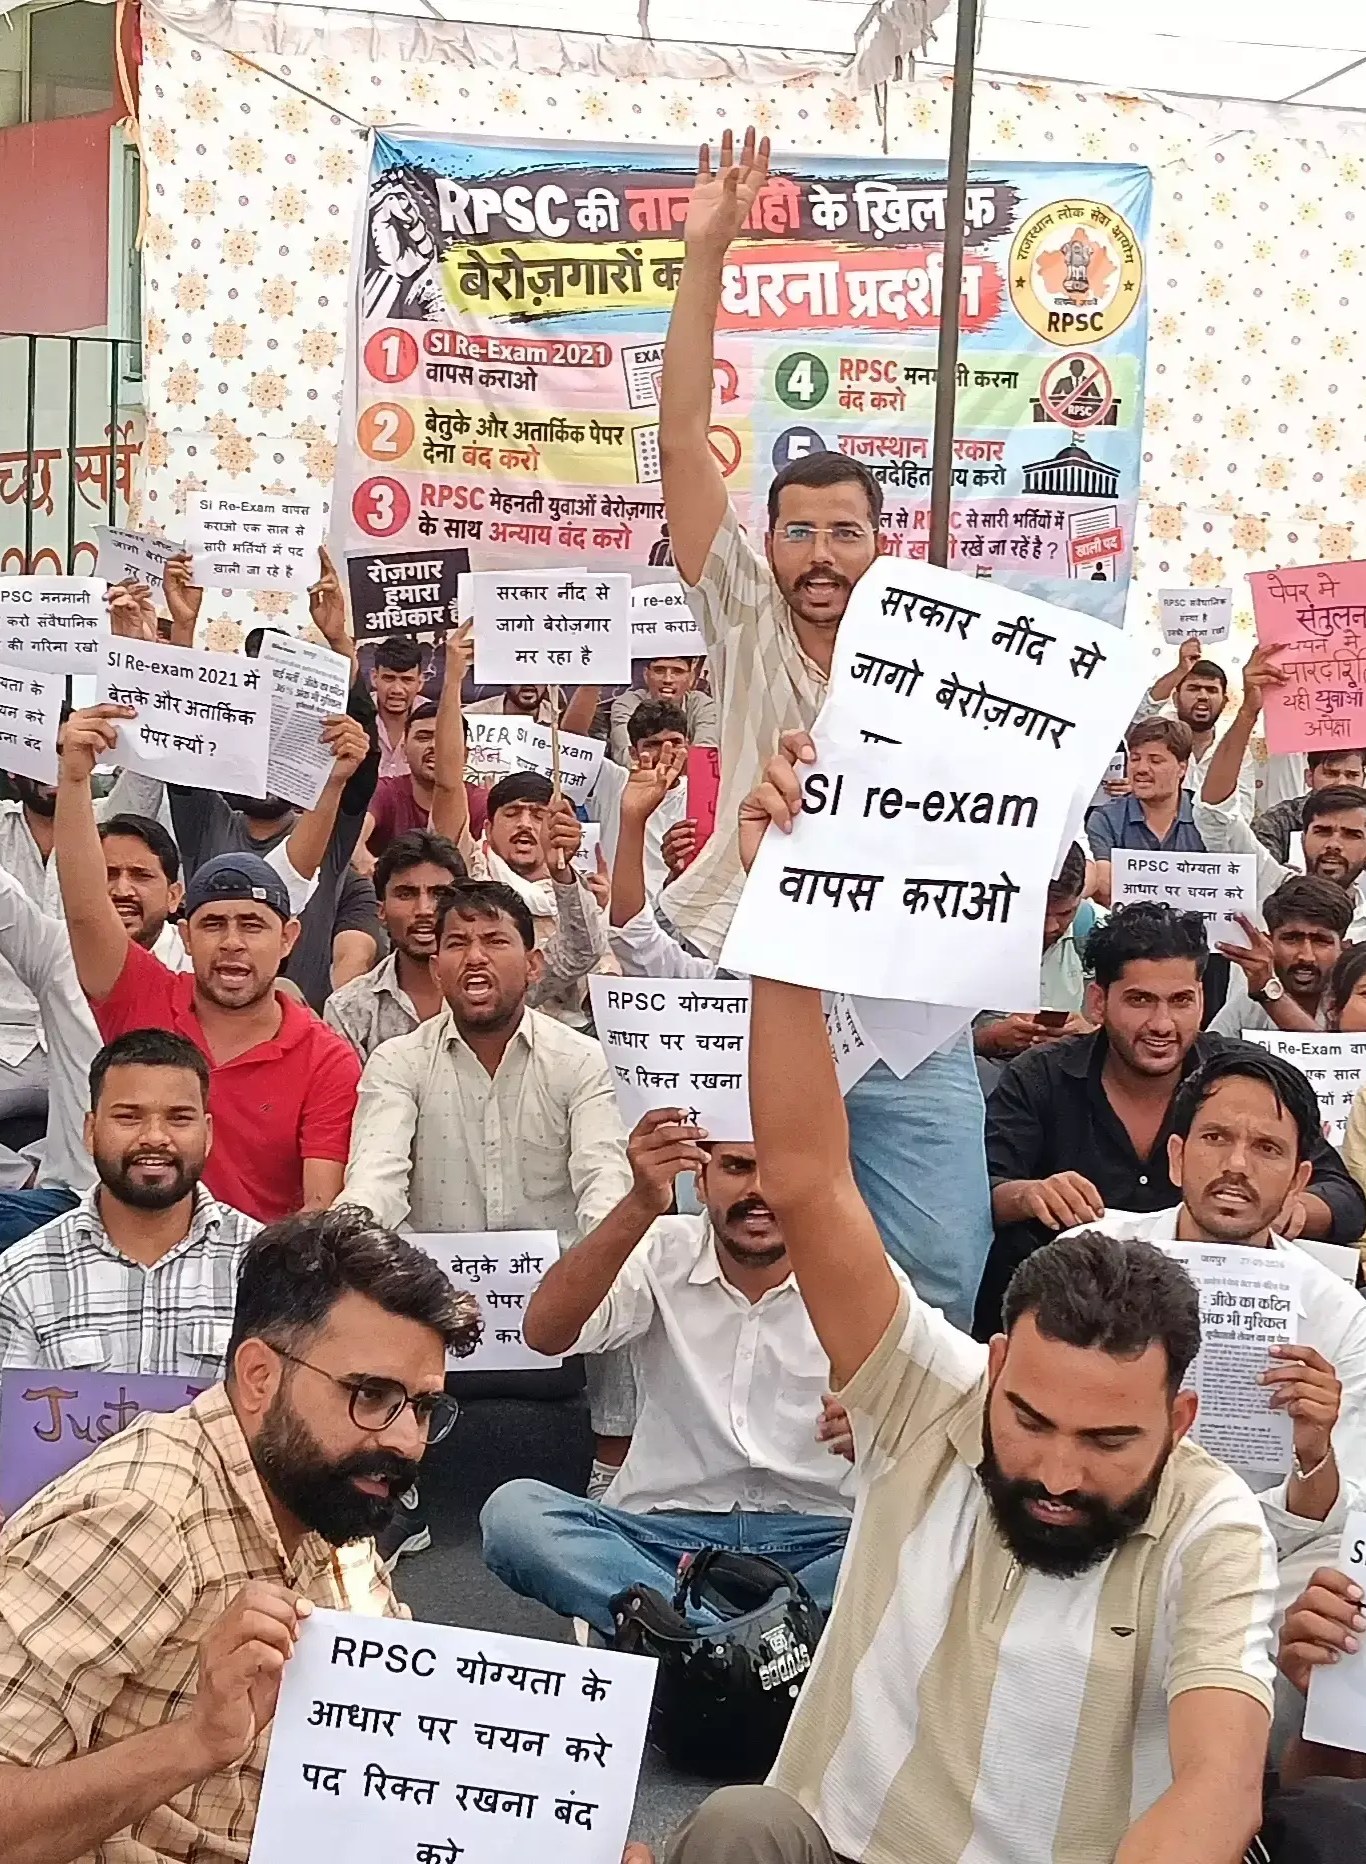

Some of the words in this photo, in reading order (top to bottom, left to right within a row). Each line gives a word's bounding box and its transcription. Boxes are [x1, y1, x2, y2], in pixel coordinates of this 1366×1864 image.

[436, 178, 577, 239] RPSC
[574, 187, 620, 233] की
[809, 184, 848, 232] के
[457, 246, 645, 307] बेरोज़गारों
[721, 260, 840, 320] धरना
[1047, 312, 1103, 332] RPSC
[382, 336, 400, 376] 1
[429, 334, 452, 357] SI
[456, 335, 548, 367] Re-Exam
[553, 343, 608, 366] 2021
[426, 362, 473, 387] वापस
[479, 366, 538, 392] कराओ
[787, 357, 815, 402] 4
[839, 357, 897, 383] RPSC
[974, 367, 1019, 390] करना
[838, 386, 865, 411] बंद
[870, 387, 906, 412] करो
[371, 410, 398, 453] 2
[424, 407, 471, 441] बेतुके
[477, 412, 508, 440] और
[512, 416, 585, 443] अतार्किक
[589, 418, 624, 446] पेपर
[423, 441, 454, 465] देना
[462, 442, 491, 470] बंद
[499, 444, 540, 472] करो
[837, 433, 928, 460] राजस्थान
[973, 464, 1006, 488] करो
[219, 501, 275, 513] Re-Exam
[366, 484, 396, 531] 3
[420, 483, 485, 511] RPSC
[489, 487, 544, 514] मेहनती
[548, 492, 596, 520] युवाओं
[895, 505, 909, 528] से
[966, 506, 980, 528] से
[981, 508, 1009, 529] सारी
[418, 516, 439, 537] के
[443, 516, 482, 541] साथ
[488, 520, 552, 545] अन्याय
[558, 521, 588, 549] बंद
[593, 522, 633, 550] करो
[987, 538, 1006, 557] जा
[367, 559, 444, 589] रोज़गार
[1267, 573, 1309, 603] पेपर
[41, 589, 91, 605] मनमानी
[383, 583, 440, 604] हमारा
[496, 586, 549, 602] सरकार
[557, 581, 585, 602] नींद
[596, 582, 610, 602] से
[7, 612, 31, 629] करो
[365, 603, 445, 633] अधिकार
[496, 615, 534, 634] जागो
[880, 585, 981, 641] सरकार
[991, 615, 1057, 666] नींद
[1069, 640, 1107, 680] से
[107, 650, 121, 670] SI
[124, 655, 194, 681] Re-exam
[198, 666, 237, 687] 2021
[515, 650, 537, 665] मर
[547, 650, 572, 665] रहा
[581, 643, 593, 665] है
[153, 687, 181, 716] और
[184, 698, 257, 727] अतार्किक
[850, 651, 924, 698] जागो
[935, 671, 1076, 750] बेरोज़गार
[140, 723, 170, 748] पेपर
[207, 739, 216, 756] ?
[802, 773, 844, 817] SI
[863, 785, 1038, 829] re-exam
[1127, 859, 1169, 873] RPSC
[1228, 859, 1240, 876] के
[779, 866, 884, 913] वापस
[902, 870, 1020, 924] कराओ
[1165, 885, 1181, 899] पर
[1225, 885, 1244, 900] करे
[608, 991, 666, 1011] RPSC
[679, 993, 748, 1015] योग्यता
[660, 1033, 684, 1051] पर
[695, 1033, 744, 1052] चयन
[1278, 1042, 1342, 1055] Re-Exam
[690, 1072, 742, 1090] रखना
[1333, 1068, 1360, 1080] साल
[451, 1255, 498, 1282] बेतुके
[509, 1253, 544, 1275] और
[487, 1290, 524, 1310] पेपर
[1239, 1296, 1255, 1309] का
[330, 1636, 437, 1679] RPSC
[456, 1651, 566, 1698] योग्यता
[581, 1668, 612, 1703] के
[306, 1699, 402, 1739] आधार
[417, 1712, 457, 1746] पर
[474, 1722, 550, 1758] चयन
[565, 1732, 613, 1769] करे
[302, 1761, 347, 1796] पद
[363, 1763, 440, 1807] रिक्त
[456, 1783, 539, 1821] रखना
[554, 1789, 599, 1831] बंद
